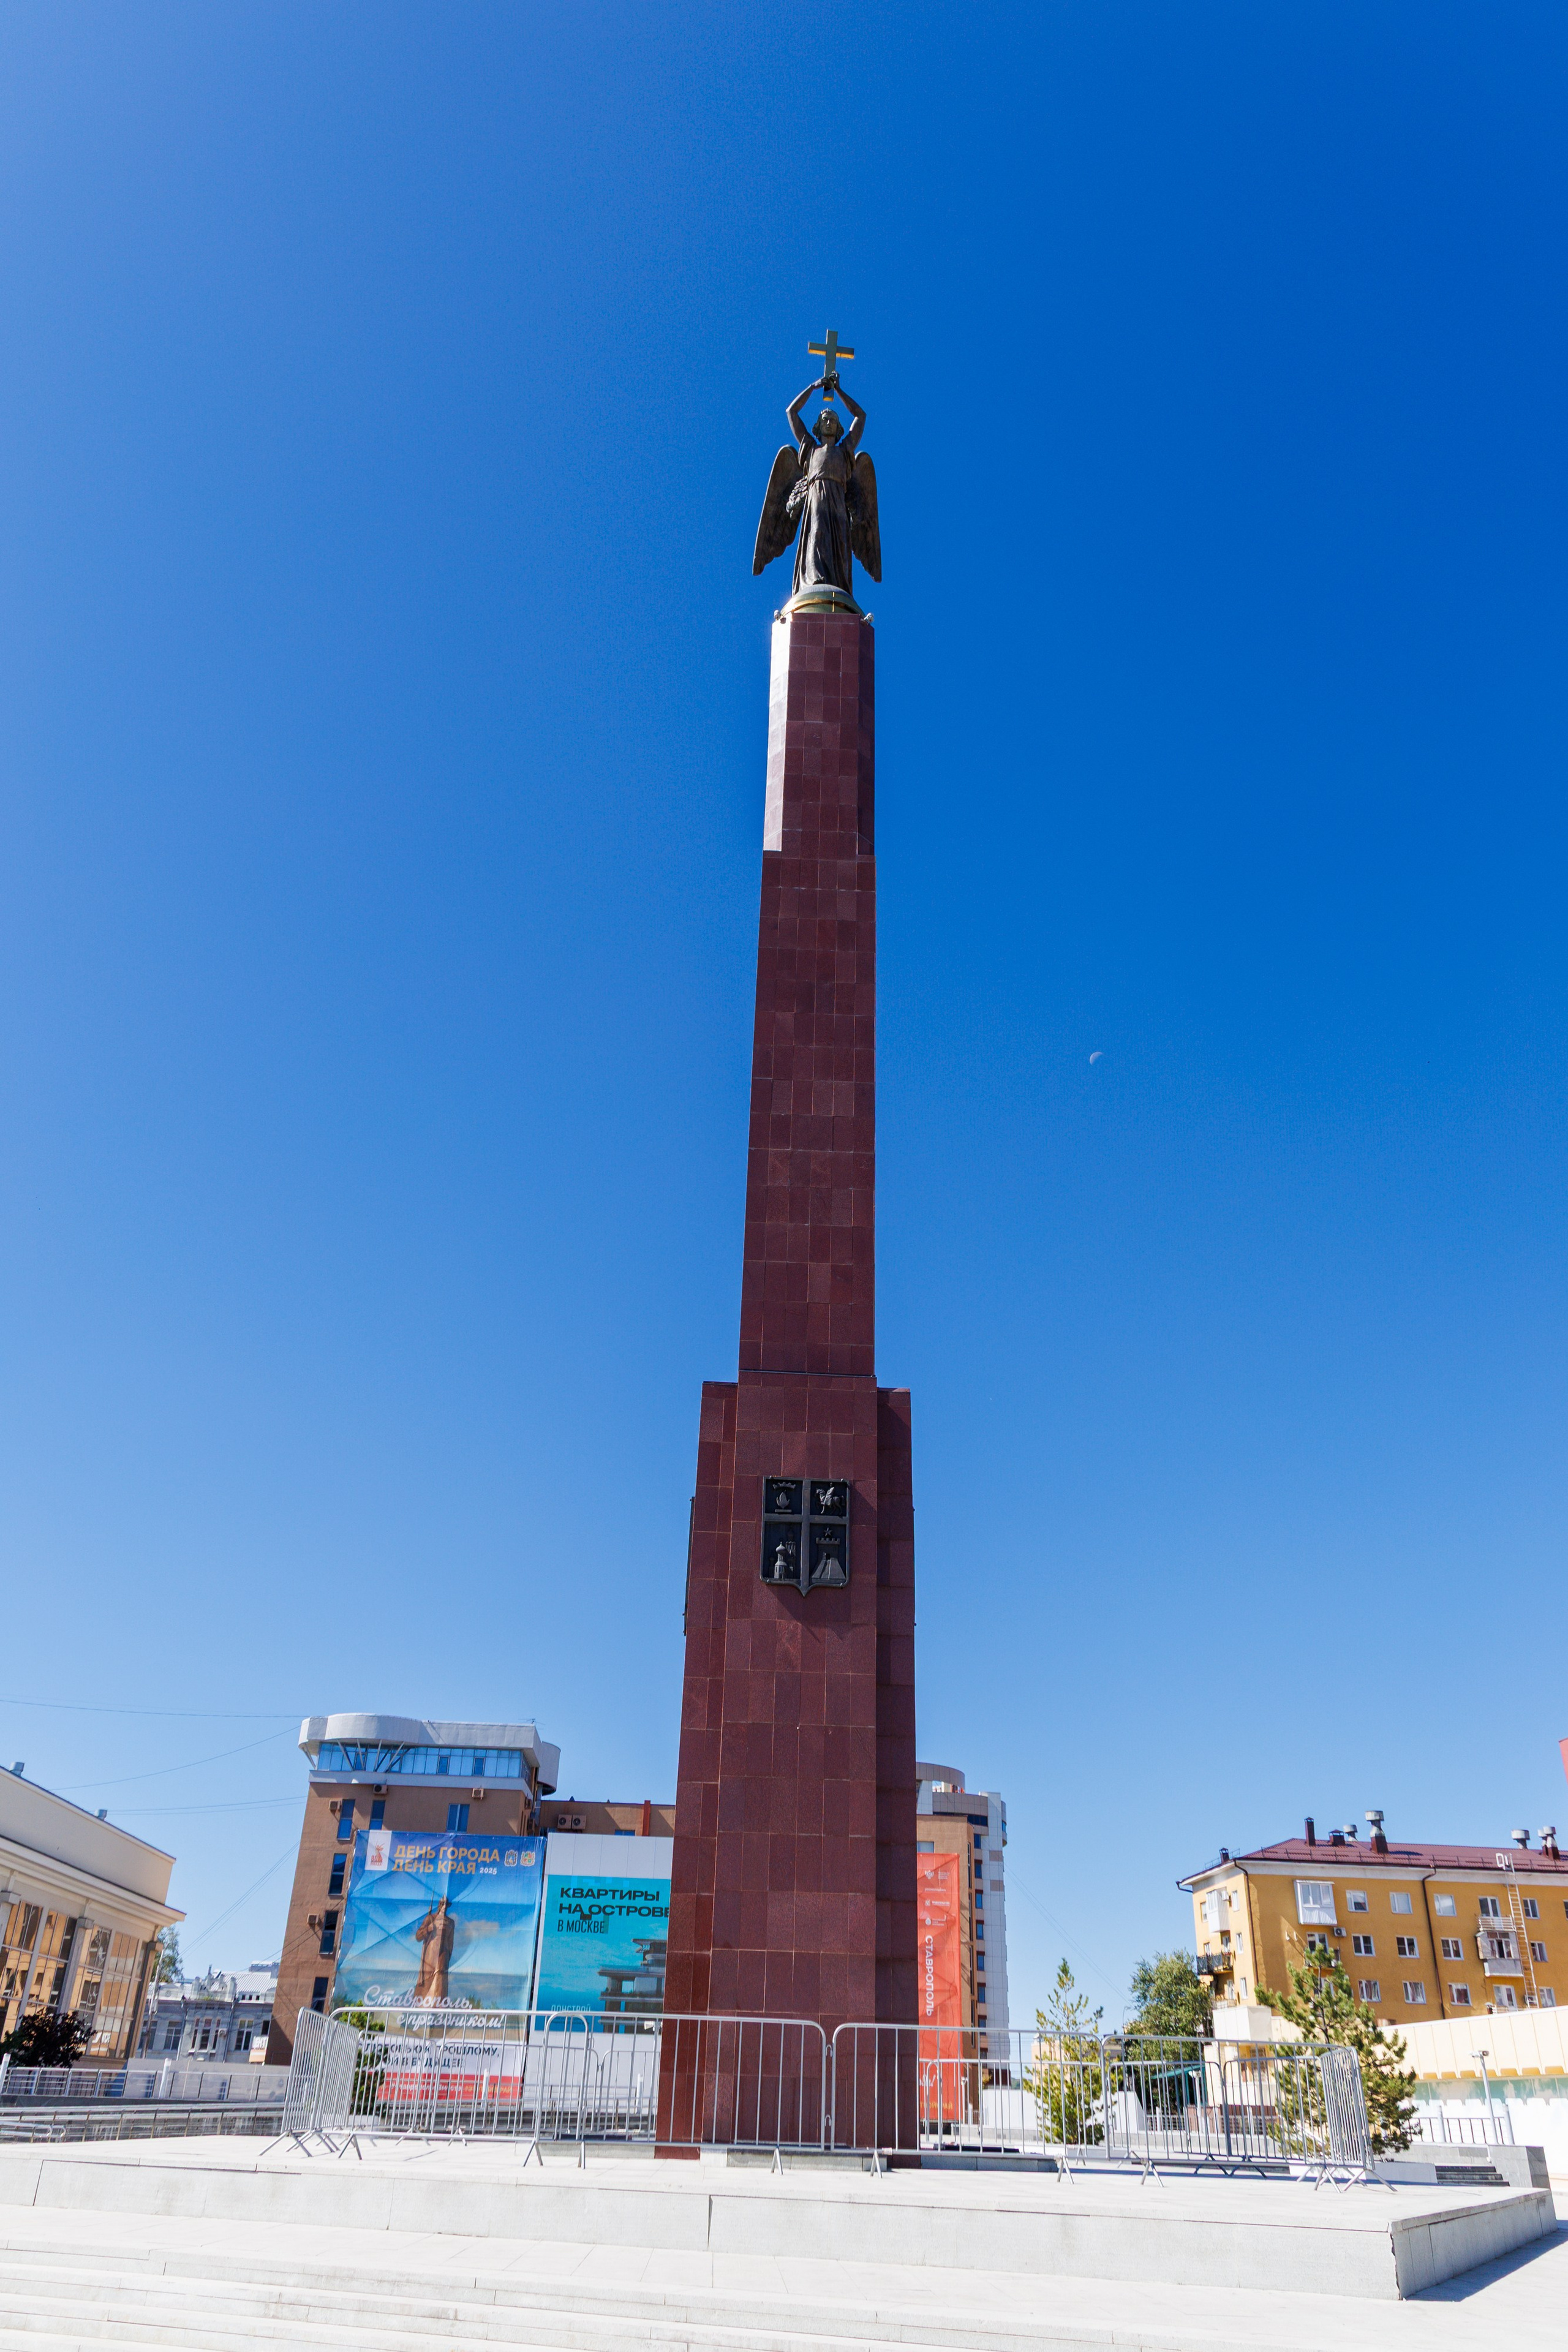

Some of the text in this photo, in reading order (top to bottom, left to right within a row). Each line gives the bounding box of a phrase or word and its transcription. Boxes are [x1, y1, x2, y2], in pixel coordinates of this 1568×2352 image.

[394, 1845, 500, 1862] ДЕНЬ ГОРОДА
[392, 1859, 434, 1873] ДЕНЬ
[437, 1860, 476, 1874] КРАЯ
[560, 1888, 660, 1901] КВАРТИРЫ
[559, 1903, 585, 1914] НА
[557, 1920, 605, 1934] В МОСКВЕ
[925, 1935, 934, 2016] СТАВРОПОЛЬ
[363, 1985, 473, 2010] Ставрополь,
